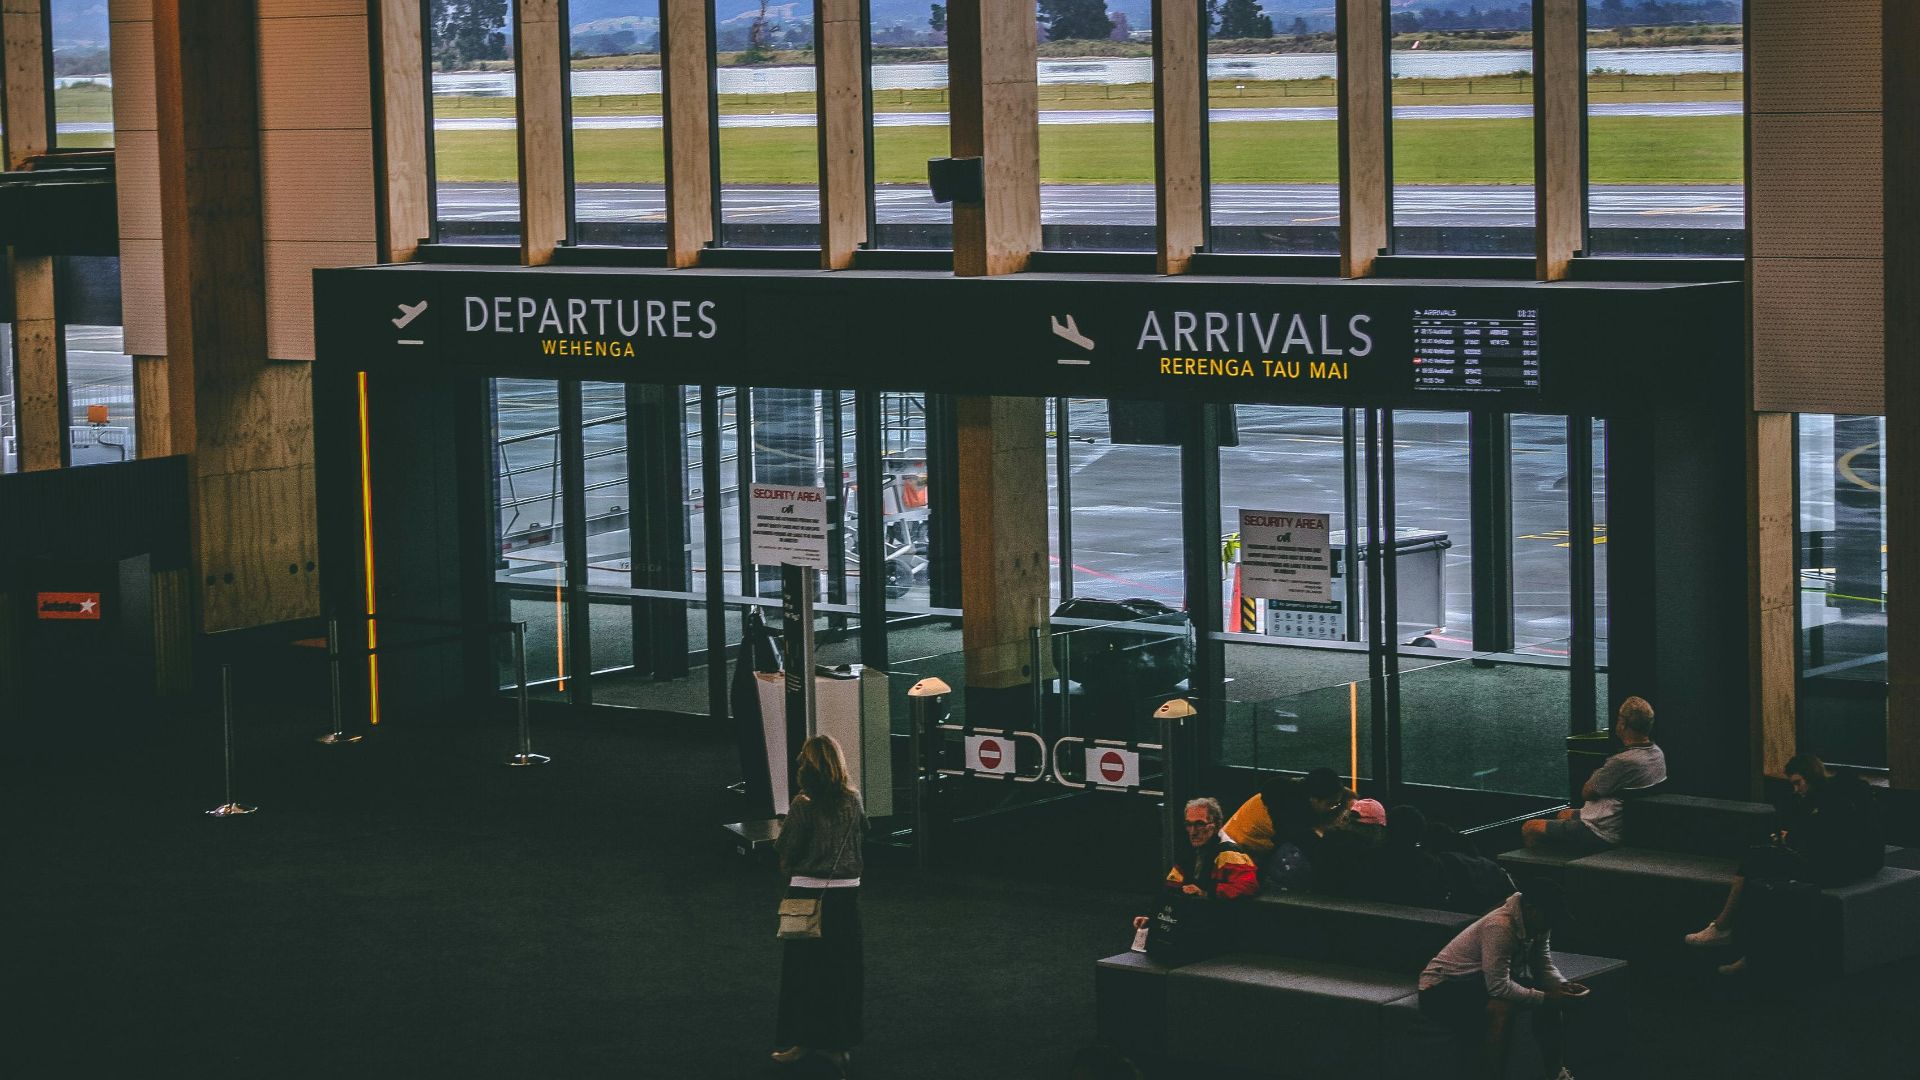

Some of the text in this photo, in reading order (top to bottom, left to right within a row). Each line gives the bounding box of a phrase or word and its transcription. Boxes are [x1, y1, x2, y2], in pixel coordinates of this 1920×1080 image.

[464, 296, 718, 339] DEPARTURES
[1423, 309, 1457, 317] ARRIVALS
[1136, 310, 1373, 358] ARRIVALS
[541, 339, 636, 358] WEHENGA
[1159, 357, 1349, 381] RERENGA TAU MAI
[753, 488, 822, 503] SECURITY AREA
[1243, 515, 1325, 530] SECURITY AREA
